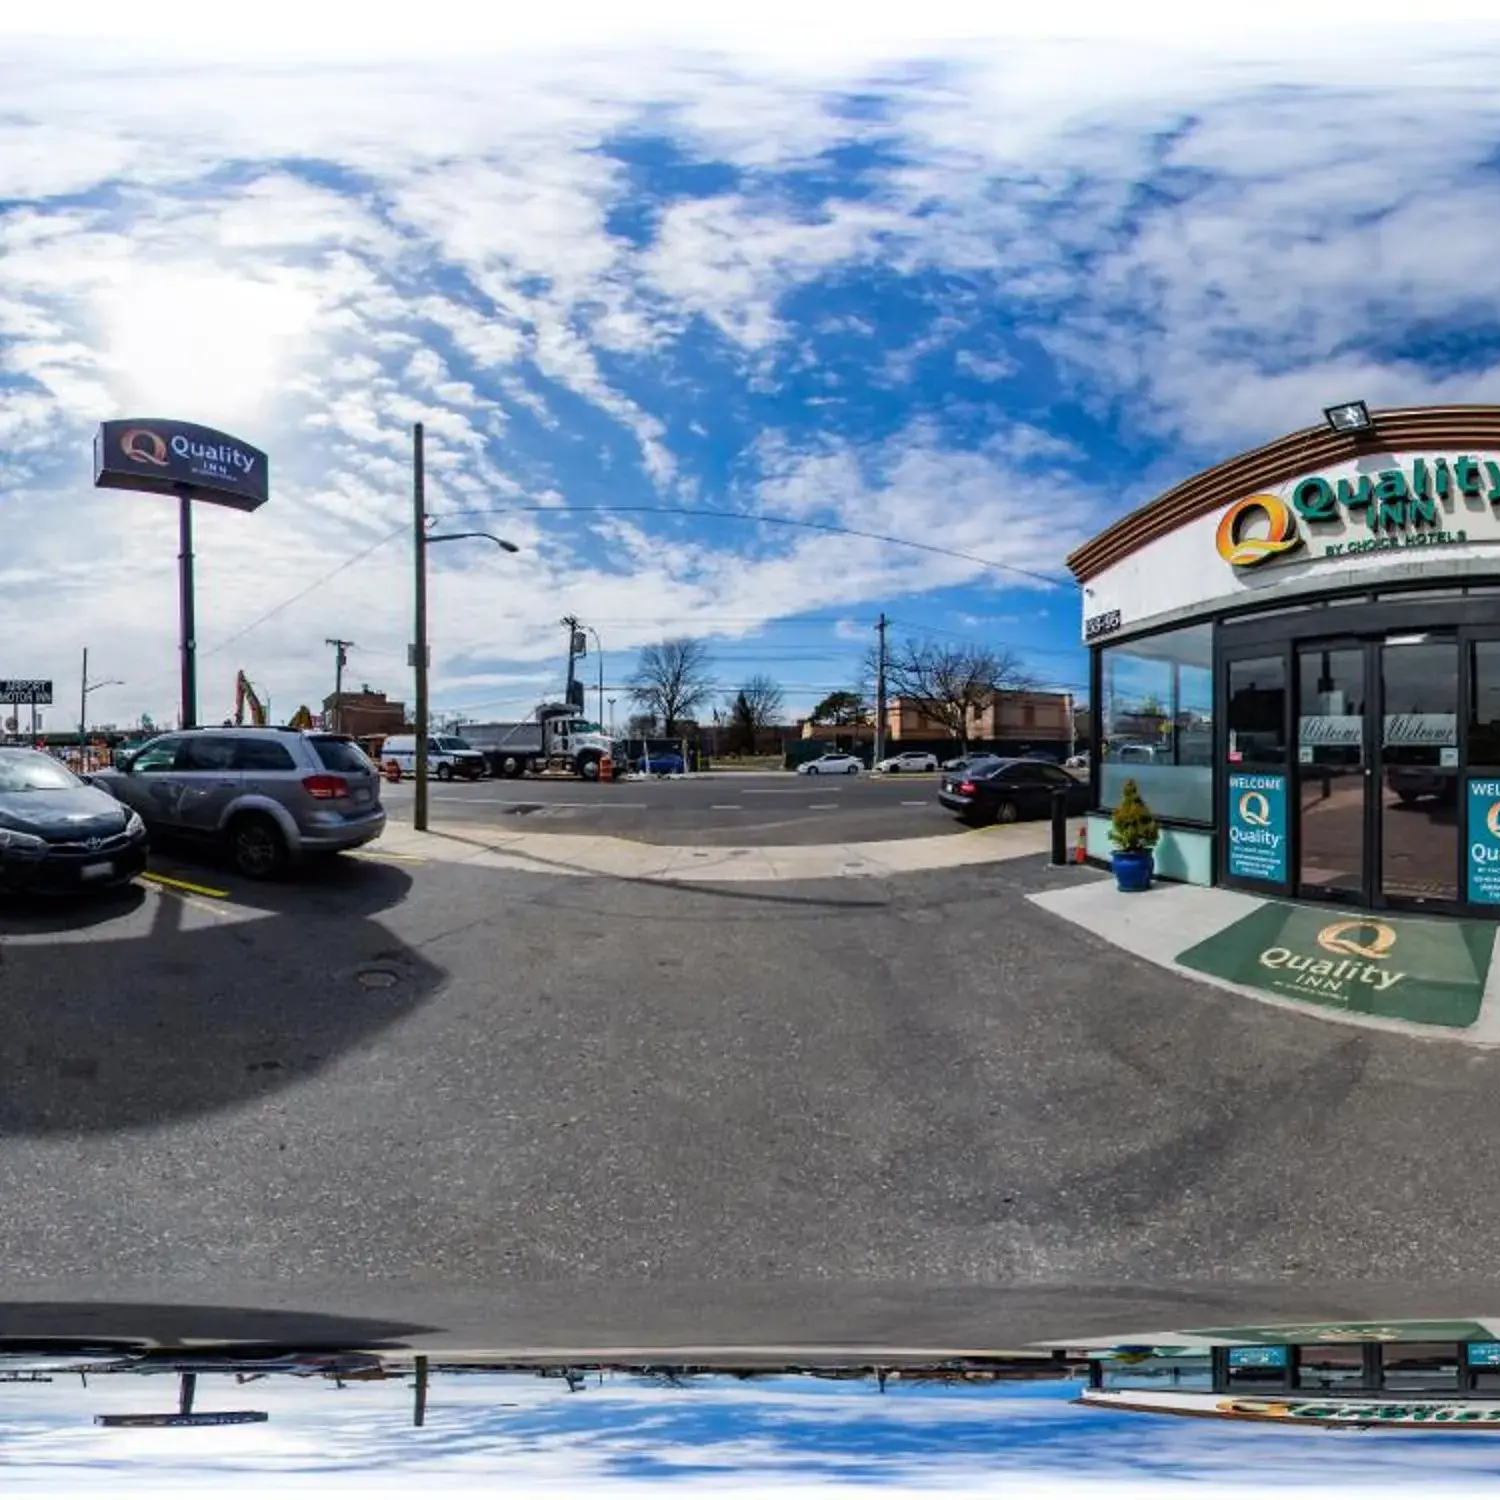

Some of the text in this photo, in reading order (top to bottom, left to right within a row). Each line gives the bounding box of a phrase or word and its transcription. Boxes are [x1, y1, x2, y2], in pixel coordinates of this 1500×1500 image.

[171, 435, 255, 473] Quality
[203, 461, 227, 473] INN
[1366, 497, 1437, 532] INN
[1325, 530, 1467, 556] BY CHOICE HOTELS
[1230, 777, 1281, 790] WELCOME
[1229, 826, 1279, 848] Quality
[1259, 947, 1406, 991] Quality
[1295, 974, 1344, 991] INN
